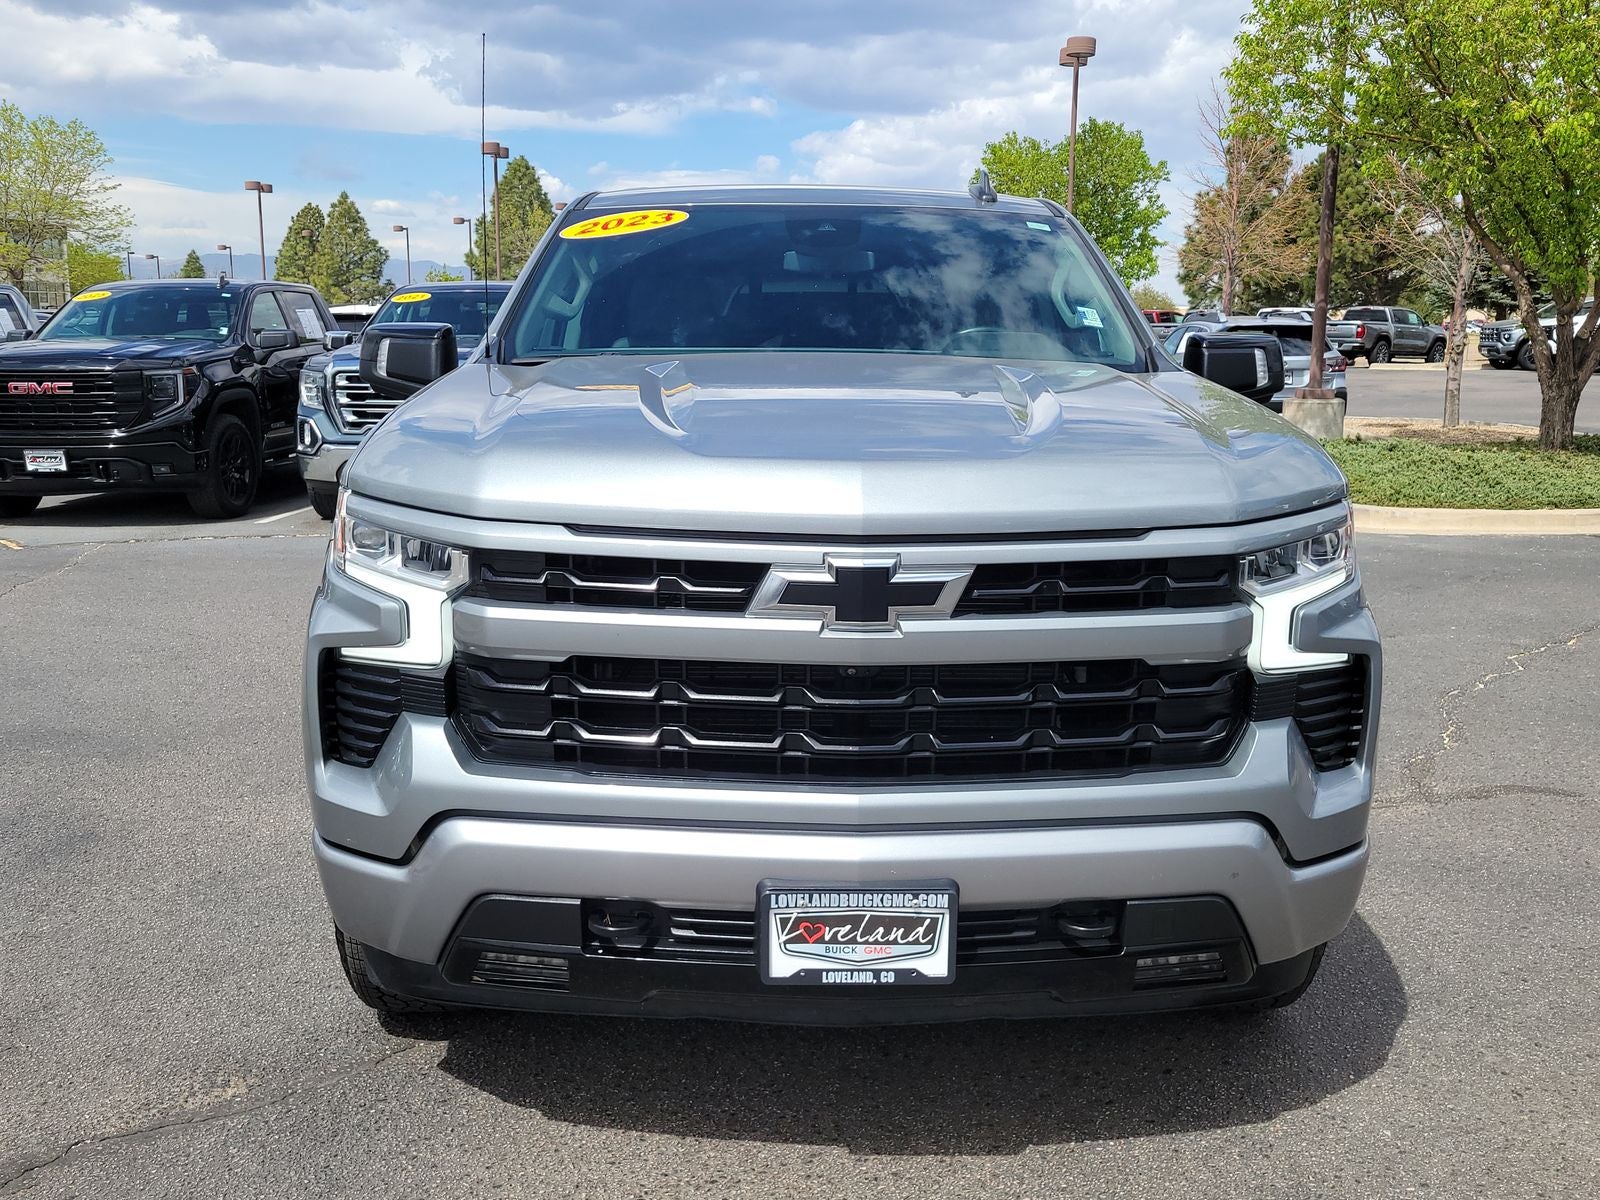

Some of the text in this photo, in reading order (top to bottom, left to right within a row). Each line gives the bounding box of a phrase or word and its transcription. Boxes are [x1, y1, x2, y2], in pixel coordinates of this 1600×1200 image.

[574, 212, 676, 236] 2023
[7, 381, 75, 395] GMC
[770, 893, 949, 908] LOVELANDBUICKGMCCOM
[778, 912, 934, 944] Loveland
[824, 945, 893, 955] BUICK GMC
[822, 971, 895, 984] LOVELAND, CO
